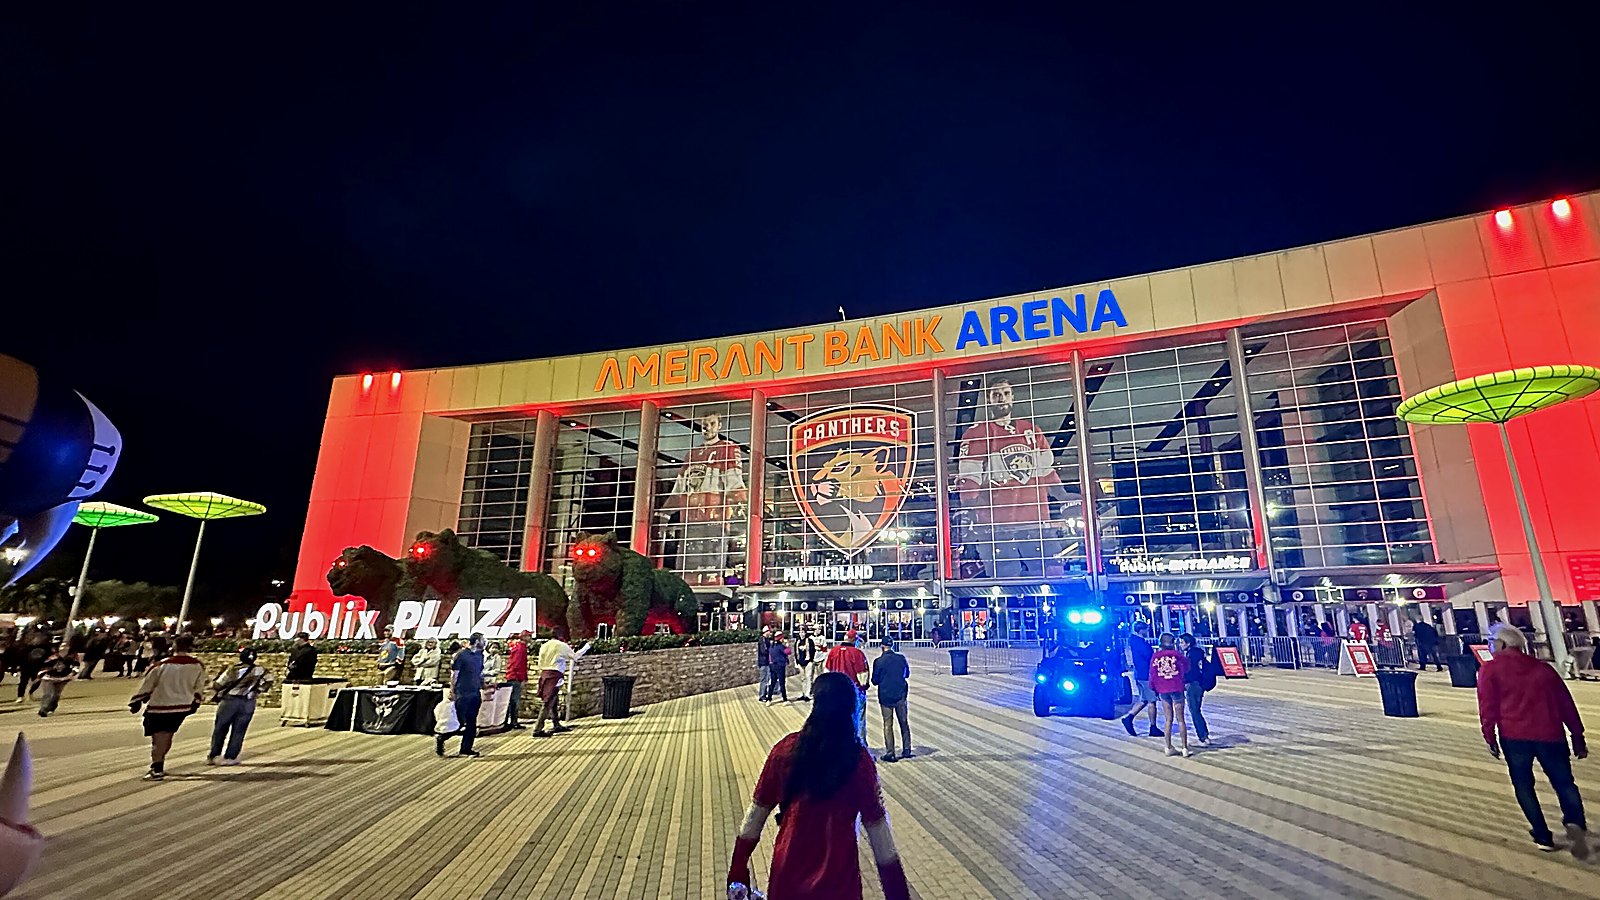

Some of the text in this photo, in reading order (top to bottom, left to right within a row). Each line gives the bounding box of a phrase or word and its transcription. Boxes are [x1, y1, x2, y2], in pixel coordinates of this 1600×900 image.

[593, 288, 1128, 391] AMERANT BANK ARENA
[803, 416, 900, 445] PANTHERS
[783, 565, 873, 581] PANTHERLAND
[1168, 556, 1251, 571] ENTRANCE
[253, 597, 537, 639] Publix PLAZA
